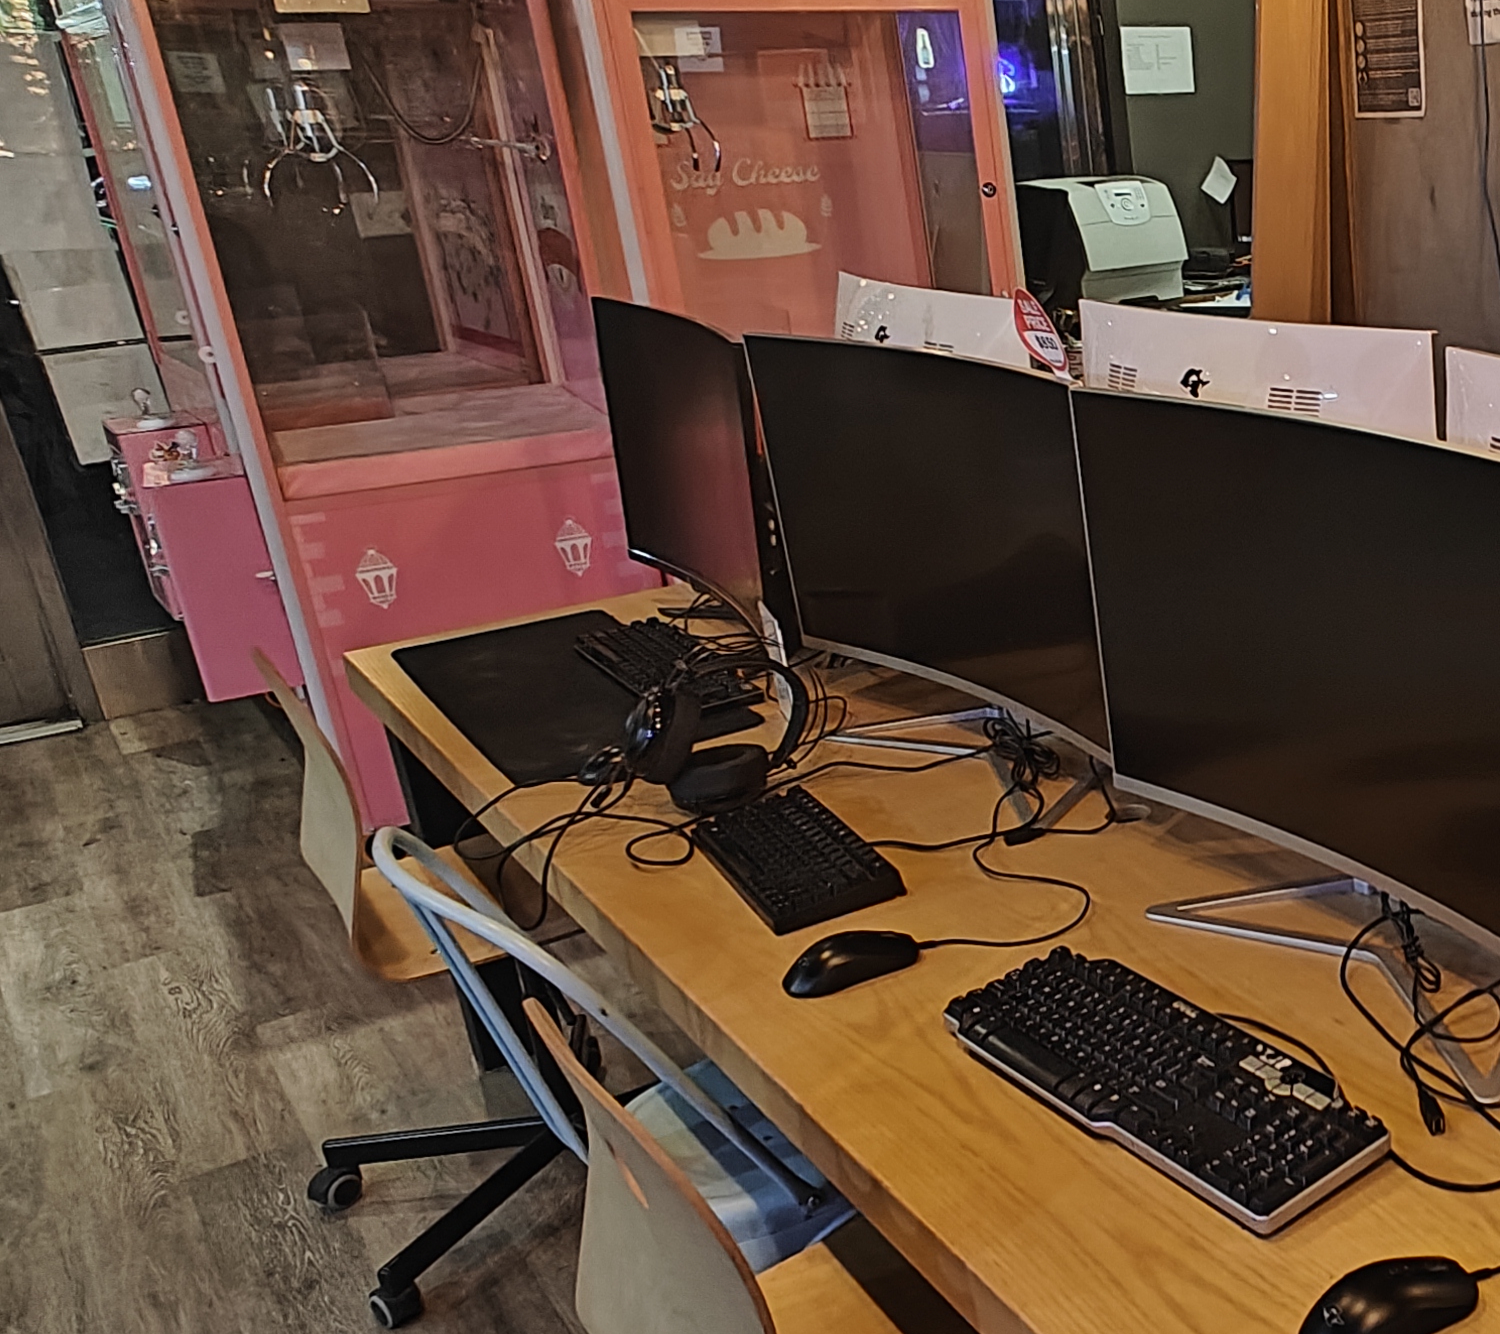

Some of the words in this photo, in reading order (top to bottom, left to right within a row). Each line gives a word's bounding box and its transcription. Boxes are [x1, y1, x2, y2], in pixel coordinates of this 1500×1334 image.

[670, 159, 724, 196] Say
[731, 156, 821, 188] Cheese
[1017, 299, 1042, 316] SALE
[1023, 315, 1052, 332] PRICE
